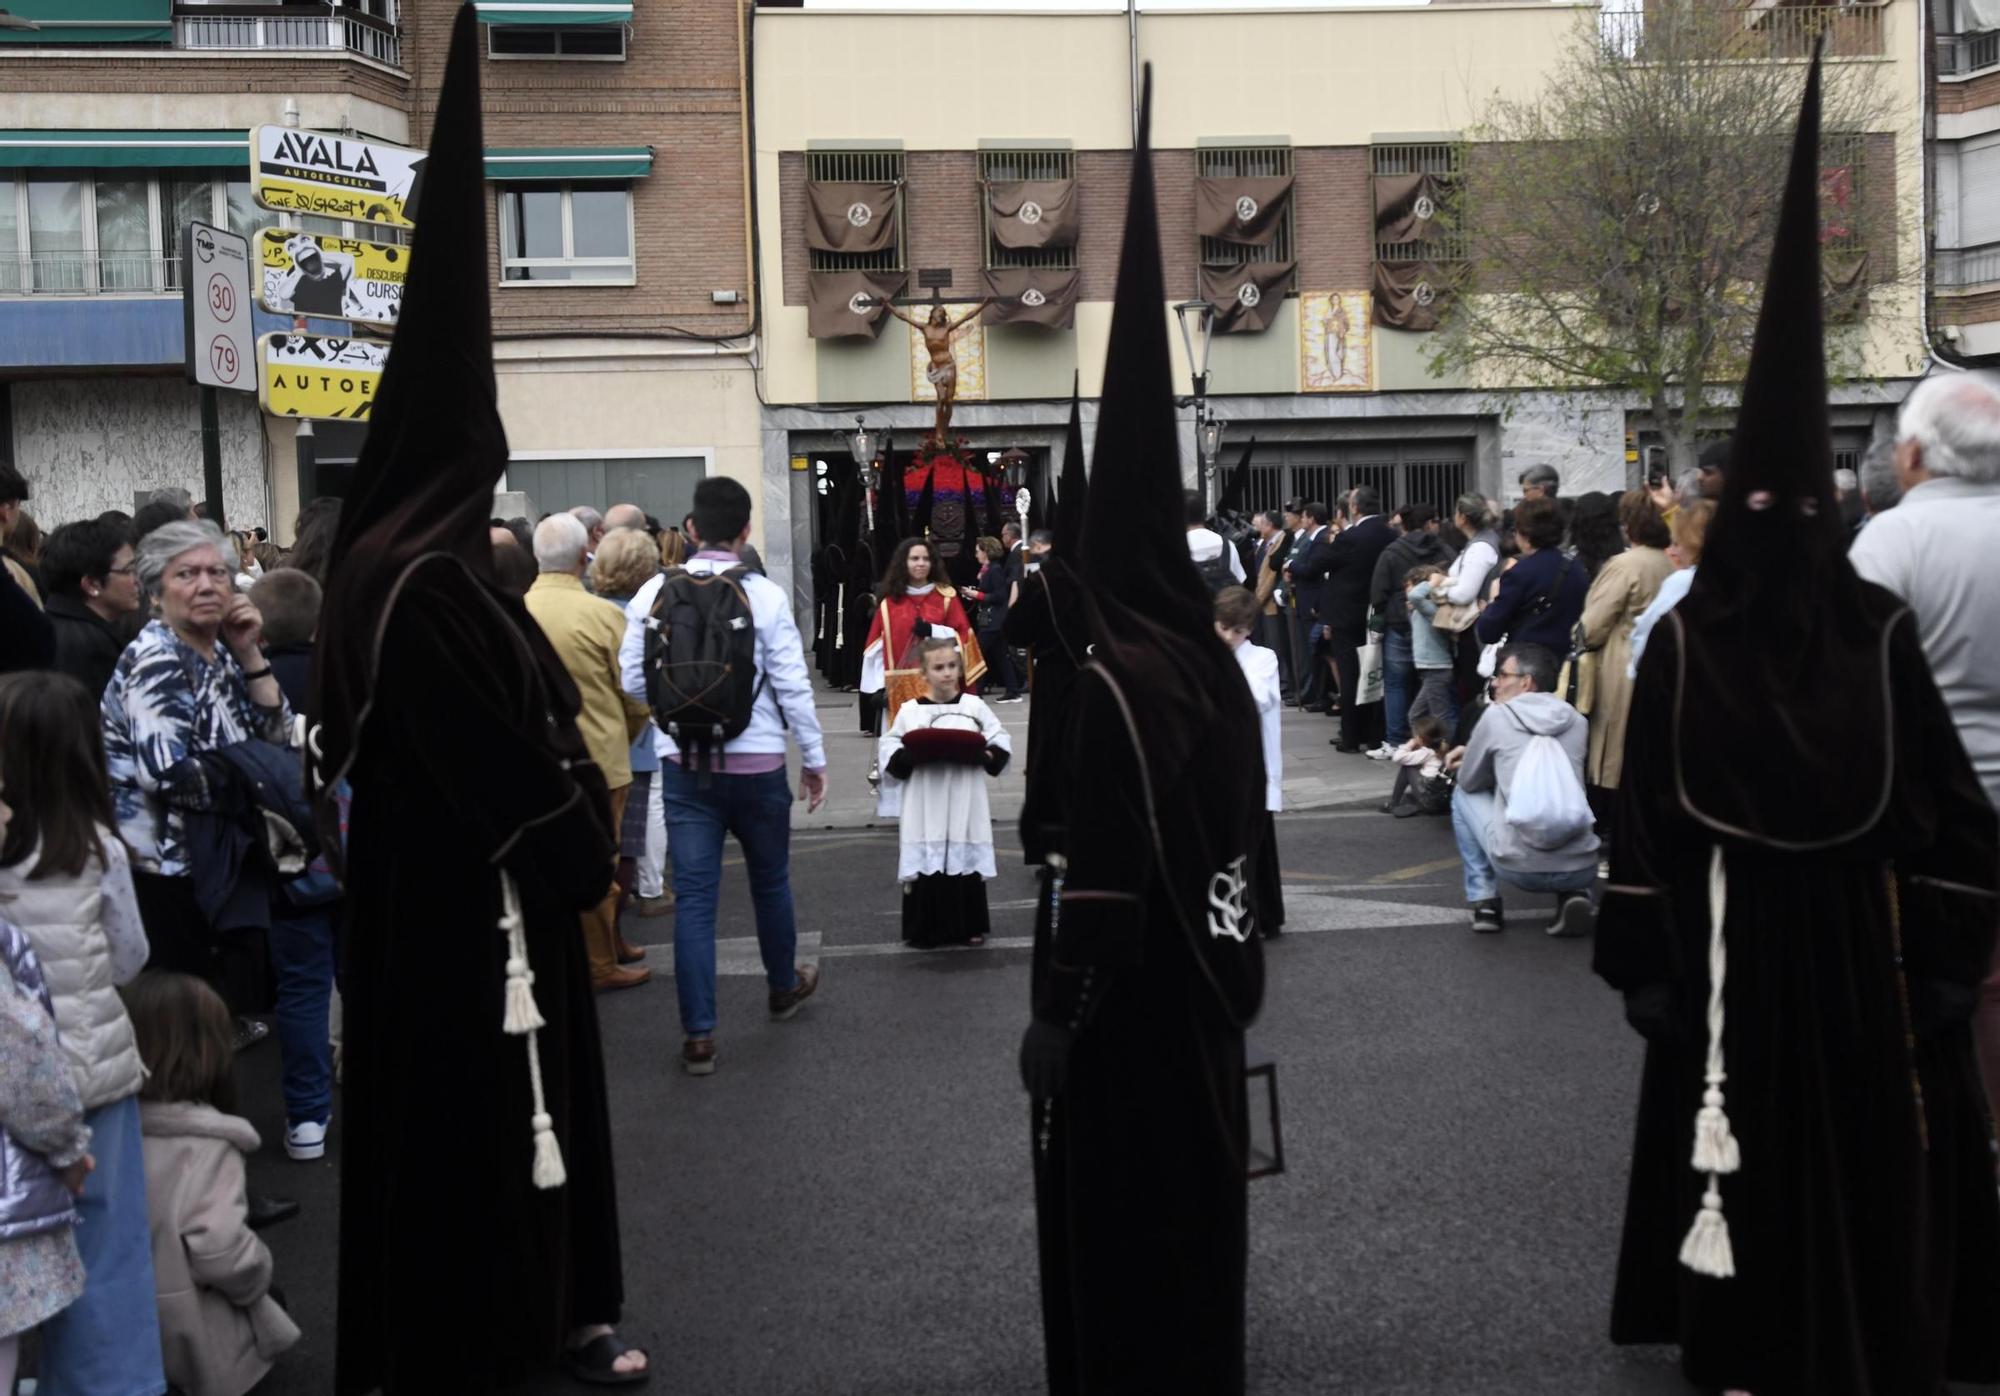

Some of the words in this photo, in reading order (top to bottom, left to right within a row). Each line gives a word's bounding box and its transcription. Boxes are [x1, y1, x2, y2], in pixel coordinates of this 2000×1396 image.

[274, 131, 380, 176] AYALA
[284, 168, 372, 188] AUTOESCUELA
[196, 238, 215, 251] TMP
[212, 284, 232, 312] 30
[214, 345, 235, 373] 79
[273, 373, 371, 395] AUTOE
